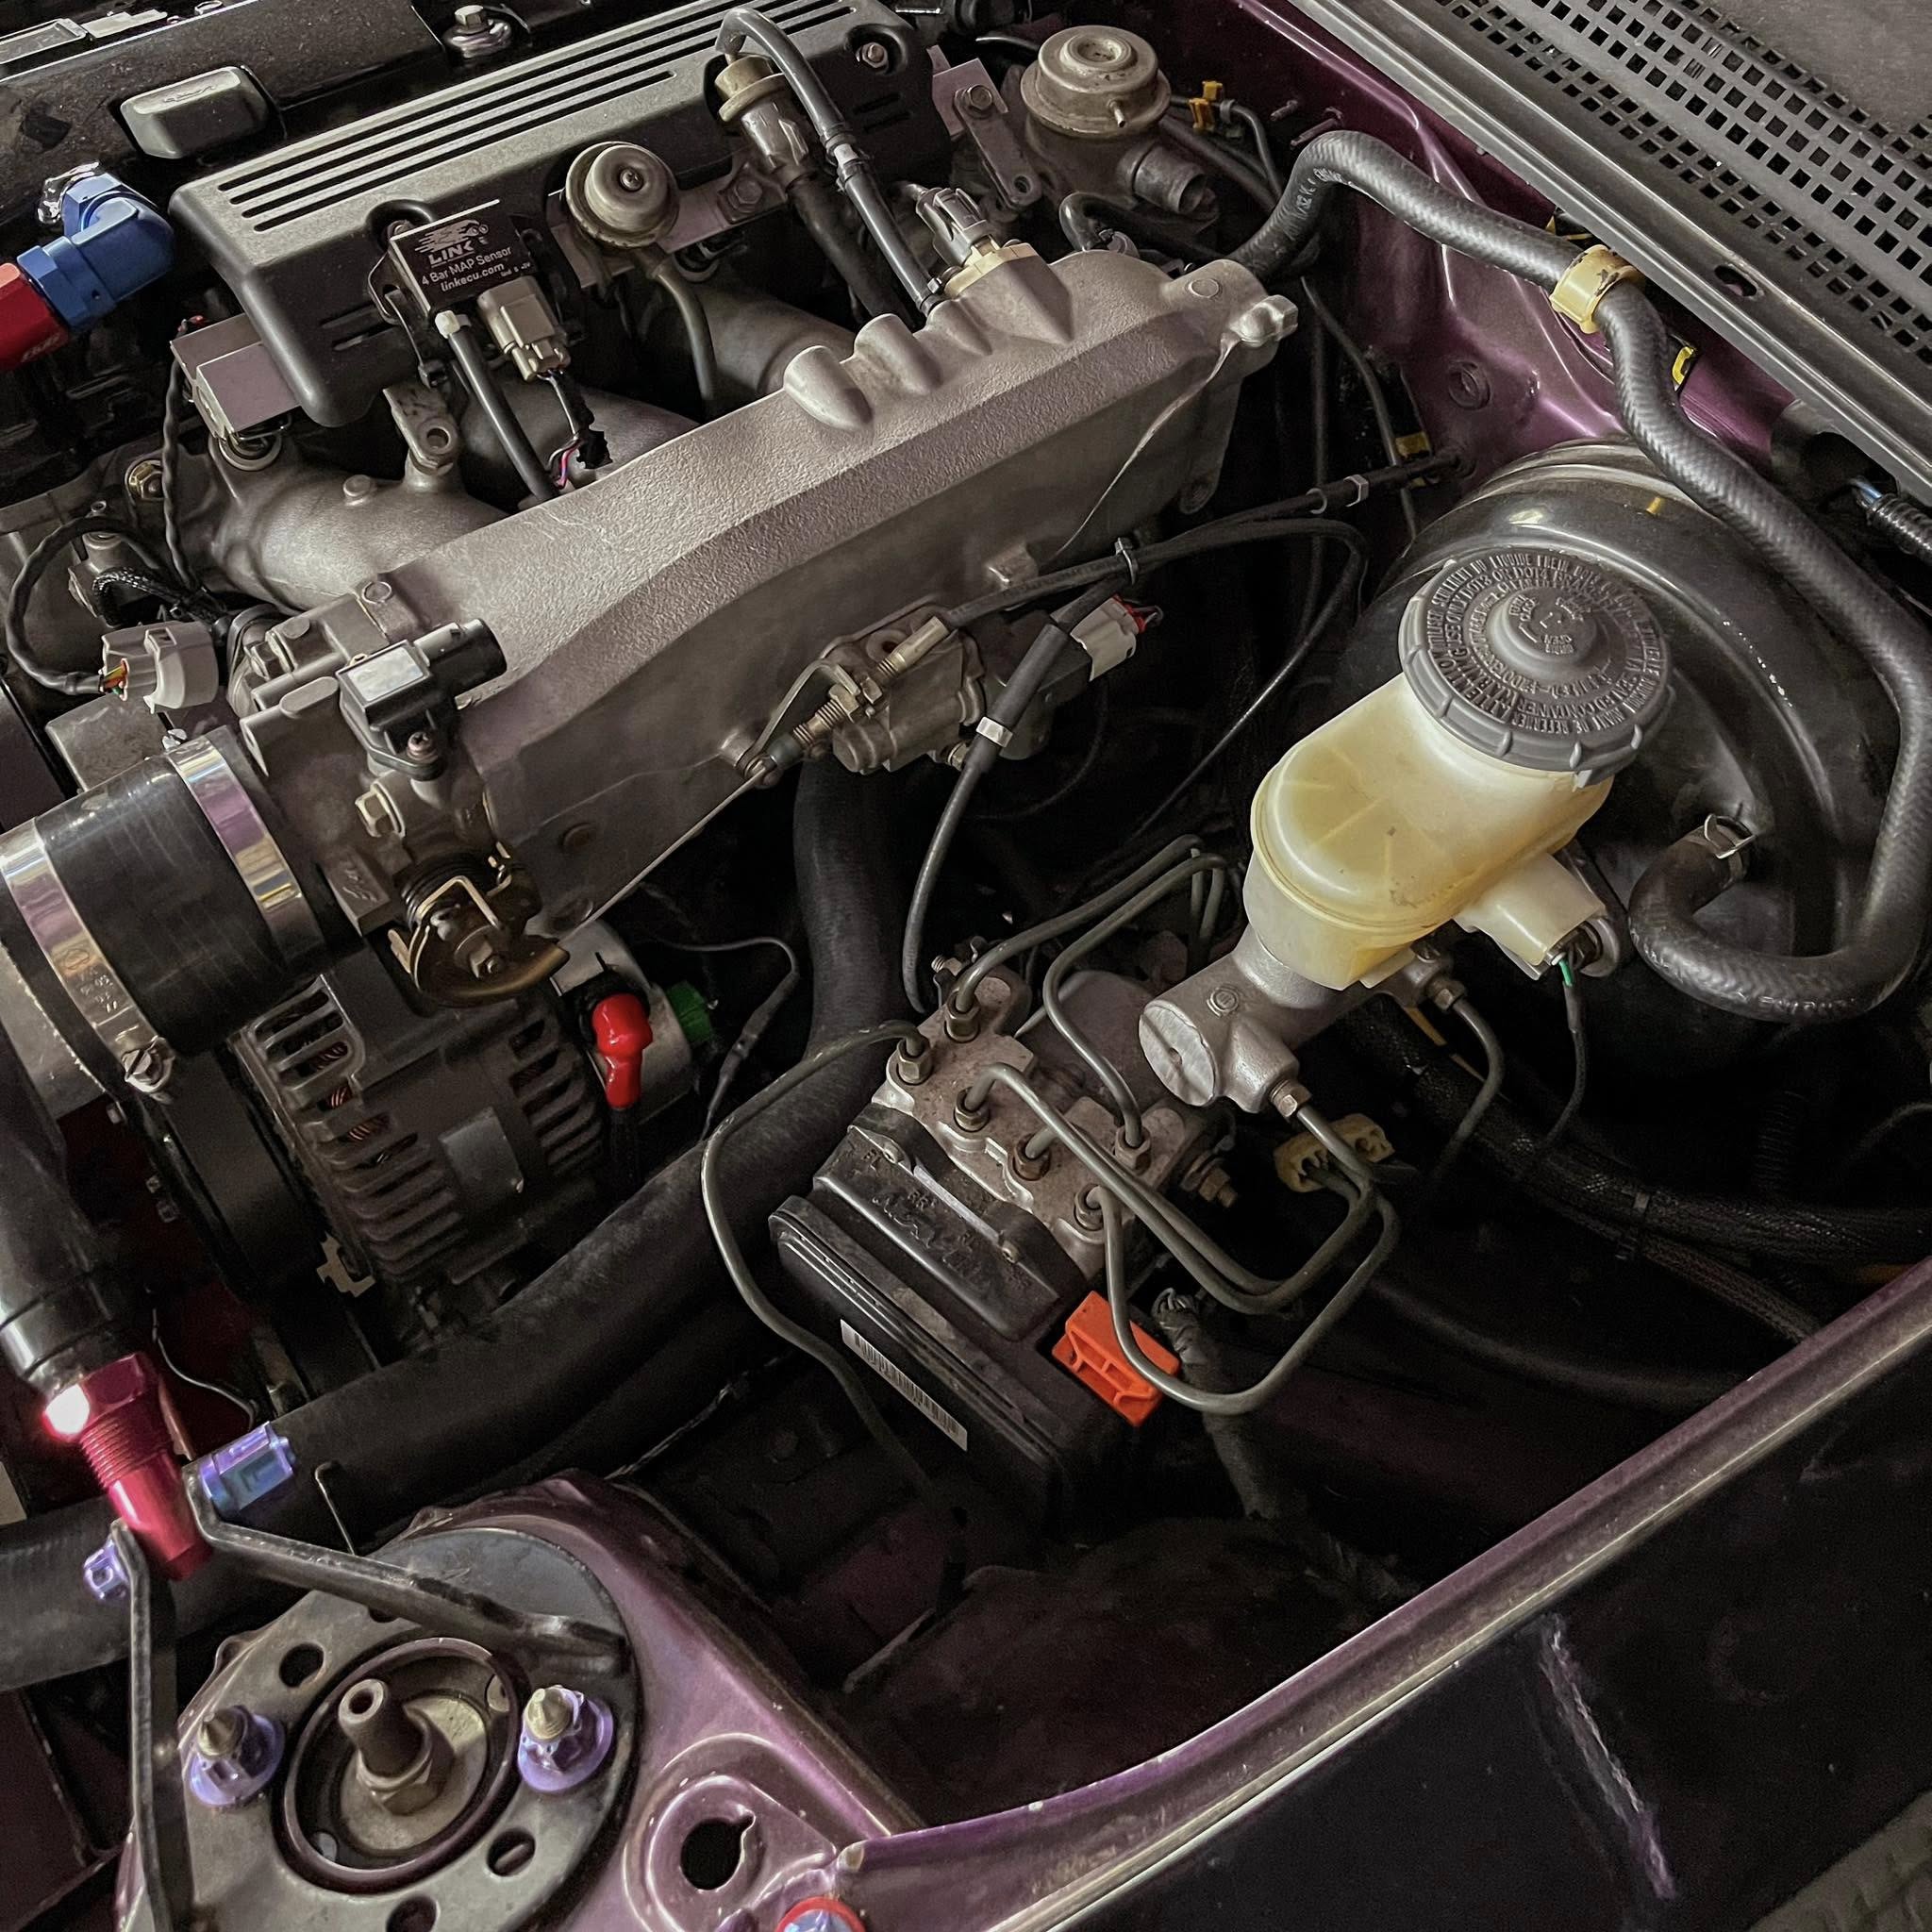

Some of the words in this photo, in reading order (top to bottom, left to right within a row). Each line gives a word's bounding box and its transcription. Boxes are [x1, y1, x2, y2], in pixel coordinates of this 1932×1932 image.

[428, 241, 475, 265] LINK
[422, 275, 429, 286] 4
[429, 269, 448, 283] Bar
[450, 258, 475, 275] MAP
[477, 246, 512, 266] Sensor
[441, 262, 505, 292] linkecu.com
[1470, 559, 1487, 574] DU
[1489, 554, 1532, 569] LIQUIDE
[1492, 568, 1511, 583] OR
[1513, 567, 1548, 580] DOT4
[1462, 575, 1491, 602] DOT3
[1446, 594, 1467, 624] ONLY
[1445, 625, 1462, 645] USE
[1431, 648, 1511, 723] ATTENTION
[1450, 646, 1516, 708] WARNING
[1517, 696, 1595, 719] CONTAINER
[1511, 711, 1569, 734] REFERMER
[1573, 719, 1590, 734] DE
